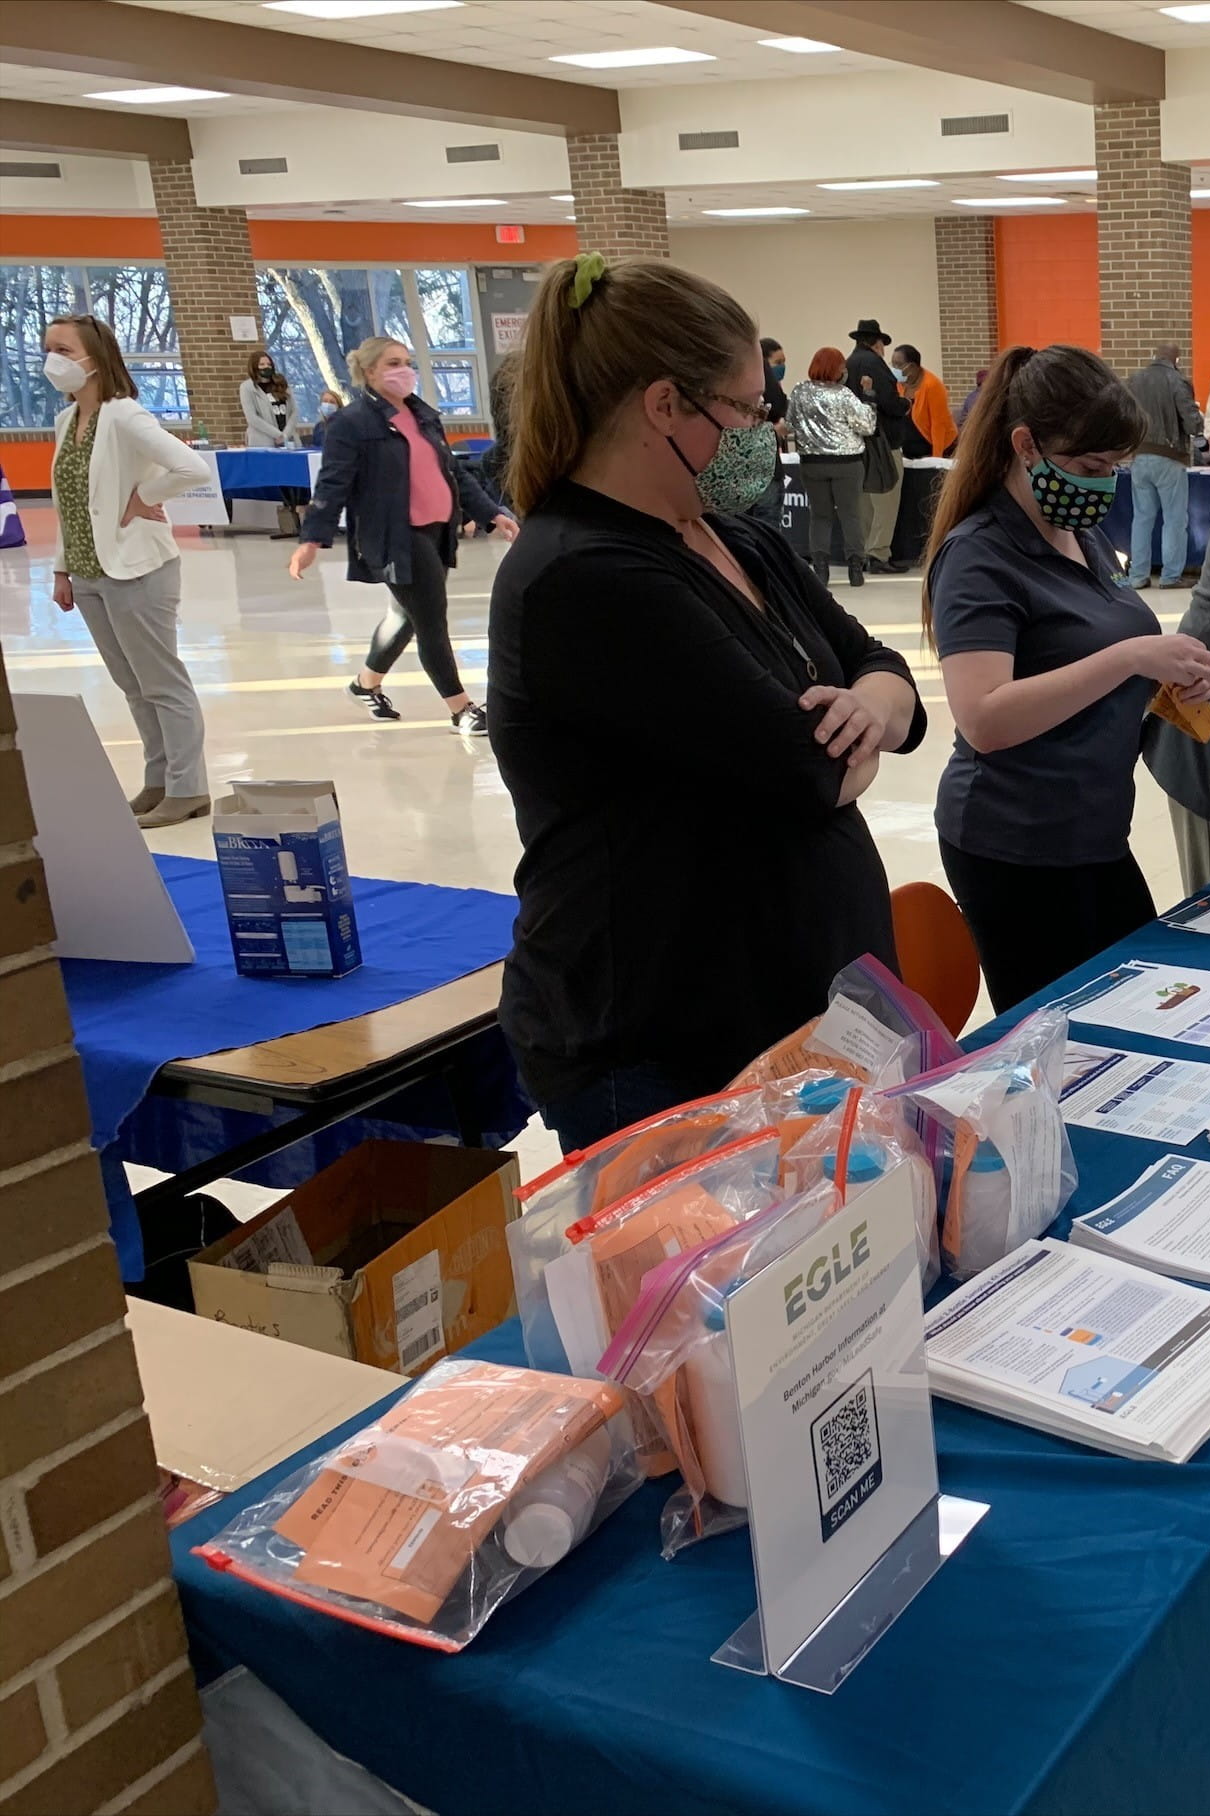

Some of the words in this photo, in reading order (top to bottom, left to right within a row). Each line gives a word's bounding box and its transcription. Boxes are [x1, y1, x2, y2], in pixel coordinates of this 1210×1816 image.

[495, 317, 523, 328] EMERG
[1161, 1163, 1186, 1180] FAQ
[784, 1220, 871, 1326] EGLE
[783, 1373, 811, 1402] Benton
[812, 1348, 837, 1376] Harbor
[838, 1312, 878, 1353] Information
[879, 1303, 887, 1316] at
[311, 1496, 333, 1521] READ
[830, 1491, 859, 1528] SCAN
[861, 1472, 876, 1498] ME
